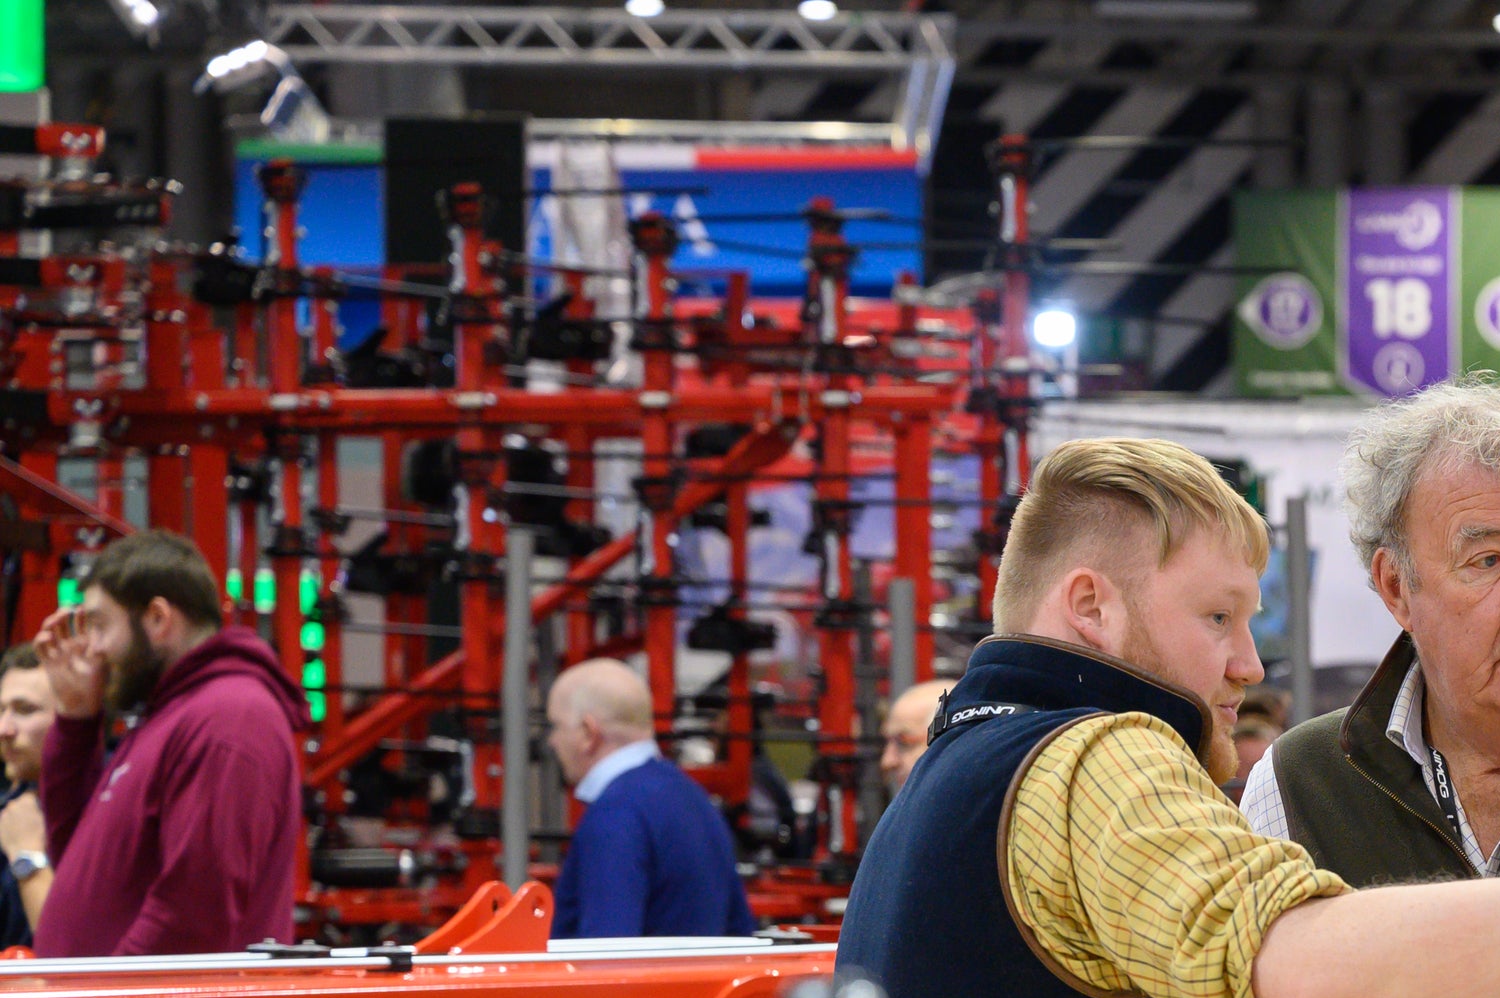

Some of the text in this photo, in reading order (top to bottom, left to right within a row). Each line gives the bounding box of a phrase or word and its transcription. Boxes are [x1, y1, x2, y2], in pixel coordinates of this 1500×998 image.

[1365, 278, 1432, 341] 18
[951, 706, 1016, 724] UNIMOG
[1432, 749, 1450, 799] NIMOG
